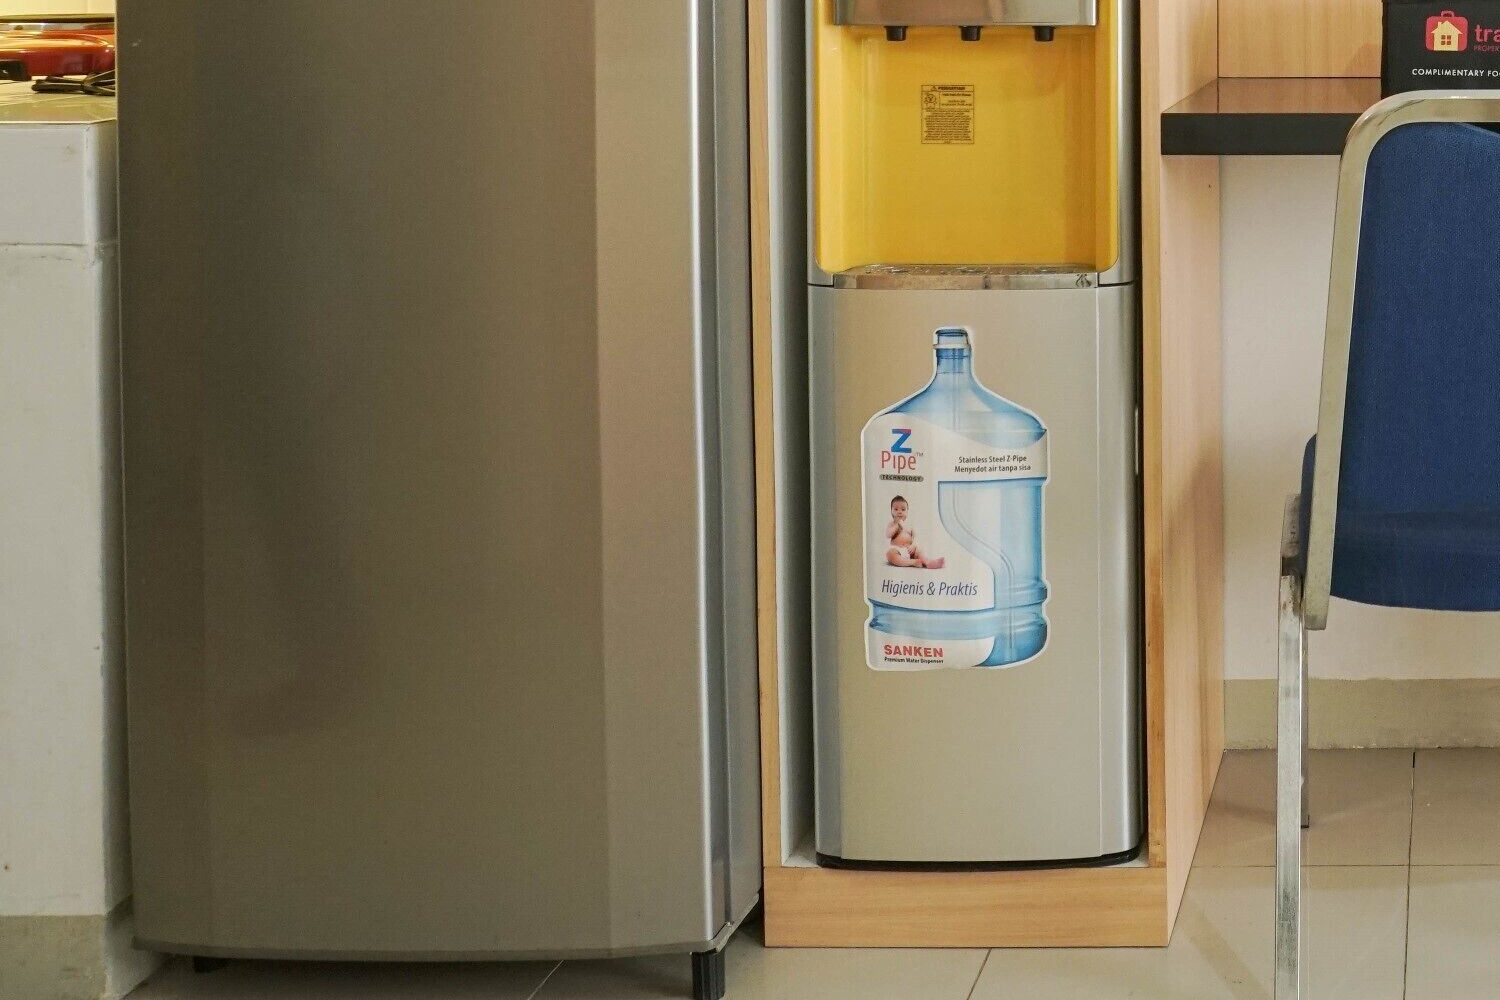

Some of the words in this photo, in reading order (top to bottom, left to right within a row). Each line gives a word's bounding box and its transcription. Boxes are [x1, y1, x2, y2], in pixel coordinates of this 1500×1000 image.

[1411, 68, 1485, 78] COMPLIMENTARY
[891, 429, 912, 453] Z
[881, 450, 916, 474] Pipe
[958, 455, 988, 463] Stainless
[988, 455, 1006, 463] Steel
[1007, 455, 1027, 464] Z-Pipe
[954, 466, 987, 474] Menyedot
[998, 465, 1018, 473] tanpa
[882, 474, 922, 482] TECHNOLOGY
[881, 579, 924, 598] Higienis
[926, 581, 936, 596] &
[938, 581, 978, 597] Praktis
[884, 644, 944, 658] SANKEN
